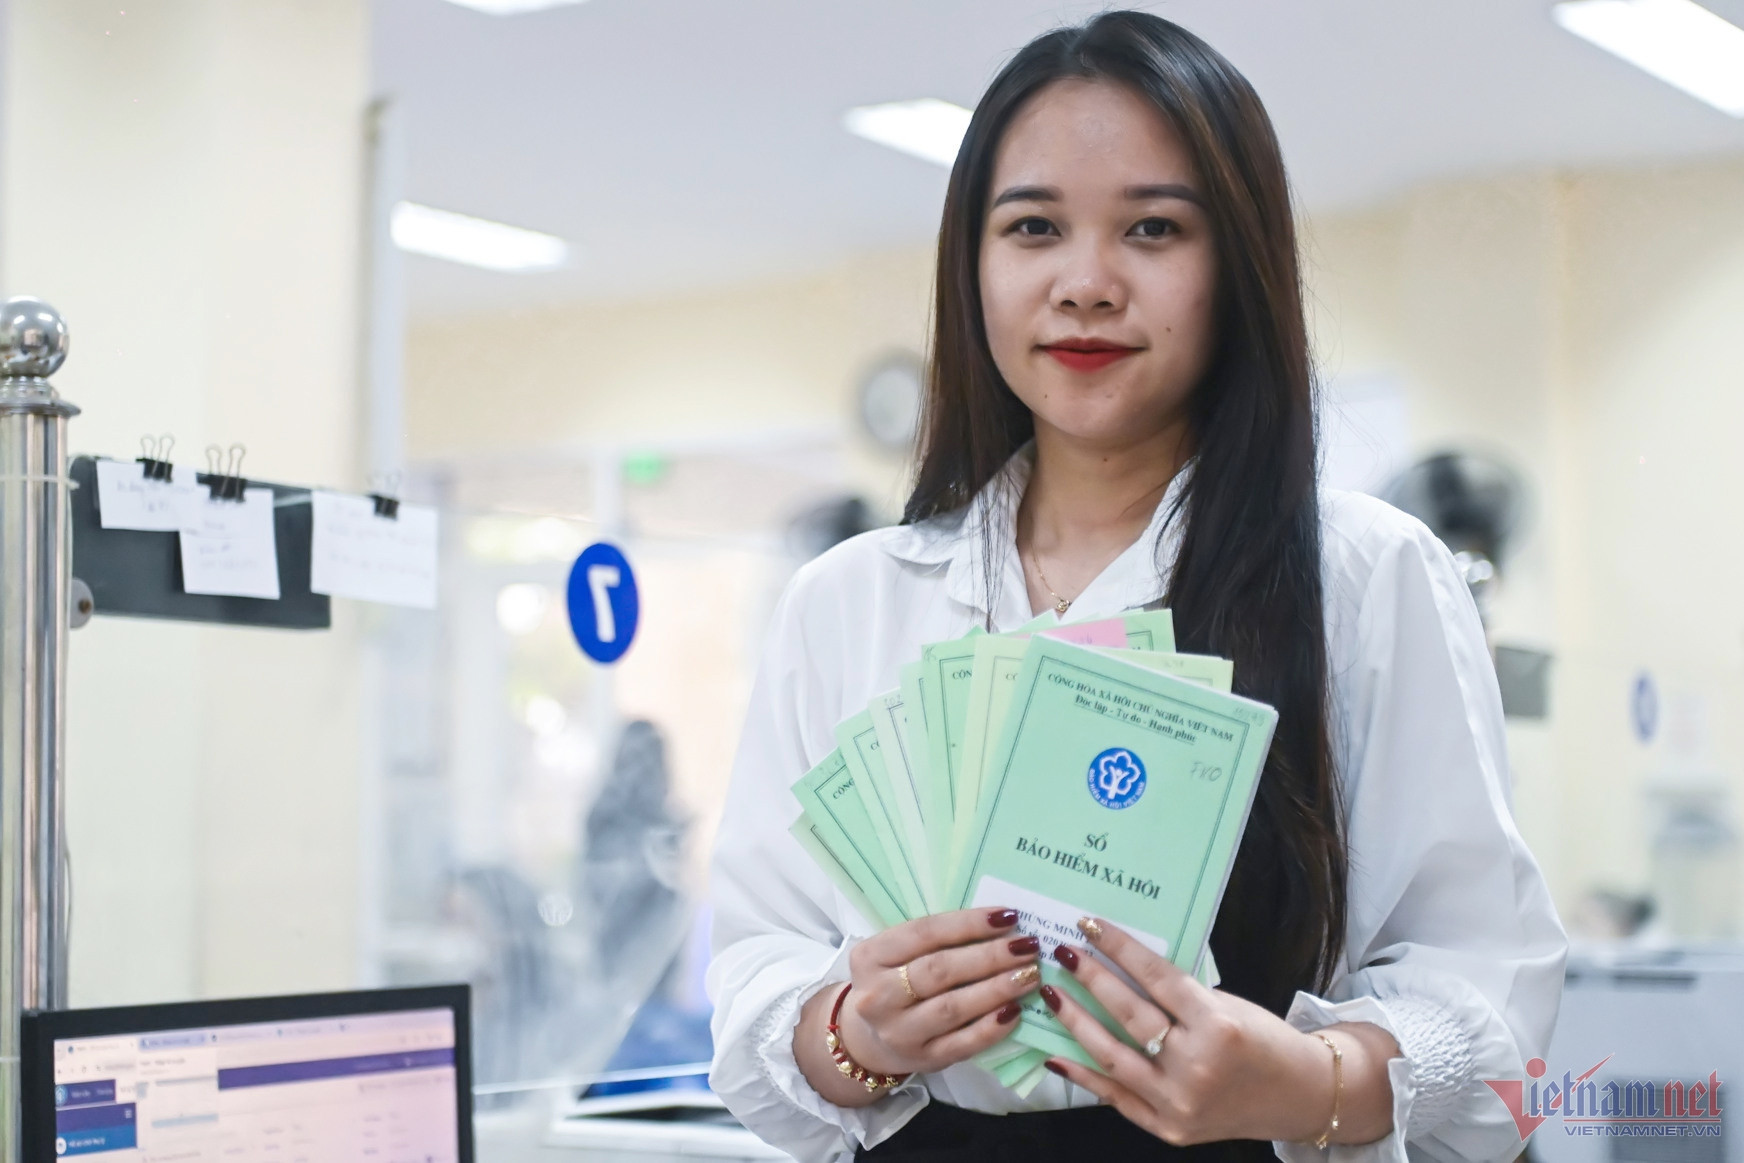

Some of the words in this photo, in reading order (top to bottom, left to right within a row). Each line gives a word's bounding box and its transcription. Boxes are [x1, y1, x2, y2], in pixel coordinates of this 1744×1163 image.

[1210, 728, 1234, 742] NAM
[1015, 837, 1051, 860] BẢO
[1052, 850, 1099, 877] HIỂM
[1101, 867, 1124, 887] XÃ
[1127, 877, 1160, 900] HỘI
[1053, 923, 1084, 941] MINH
